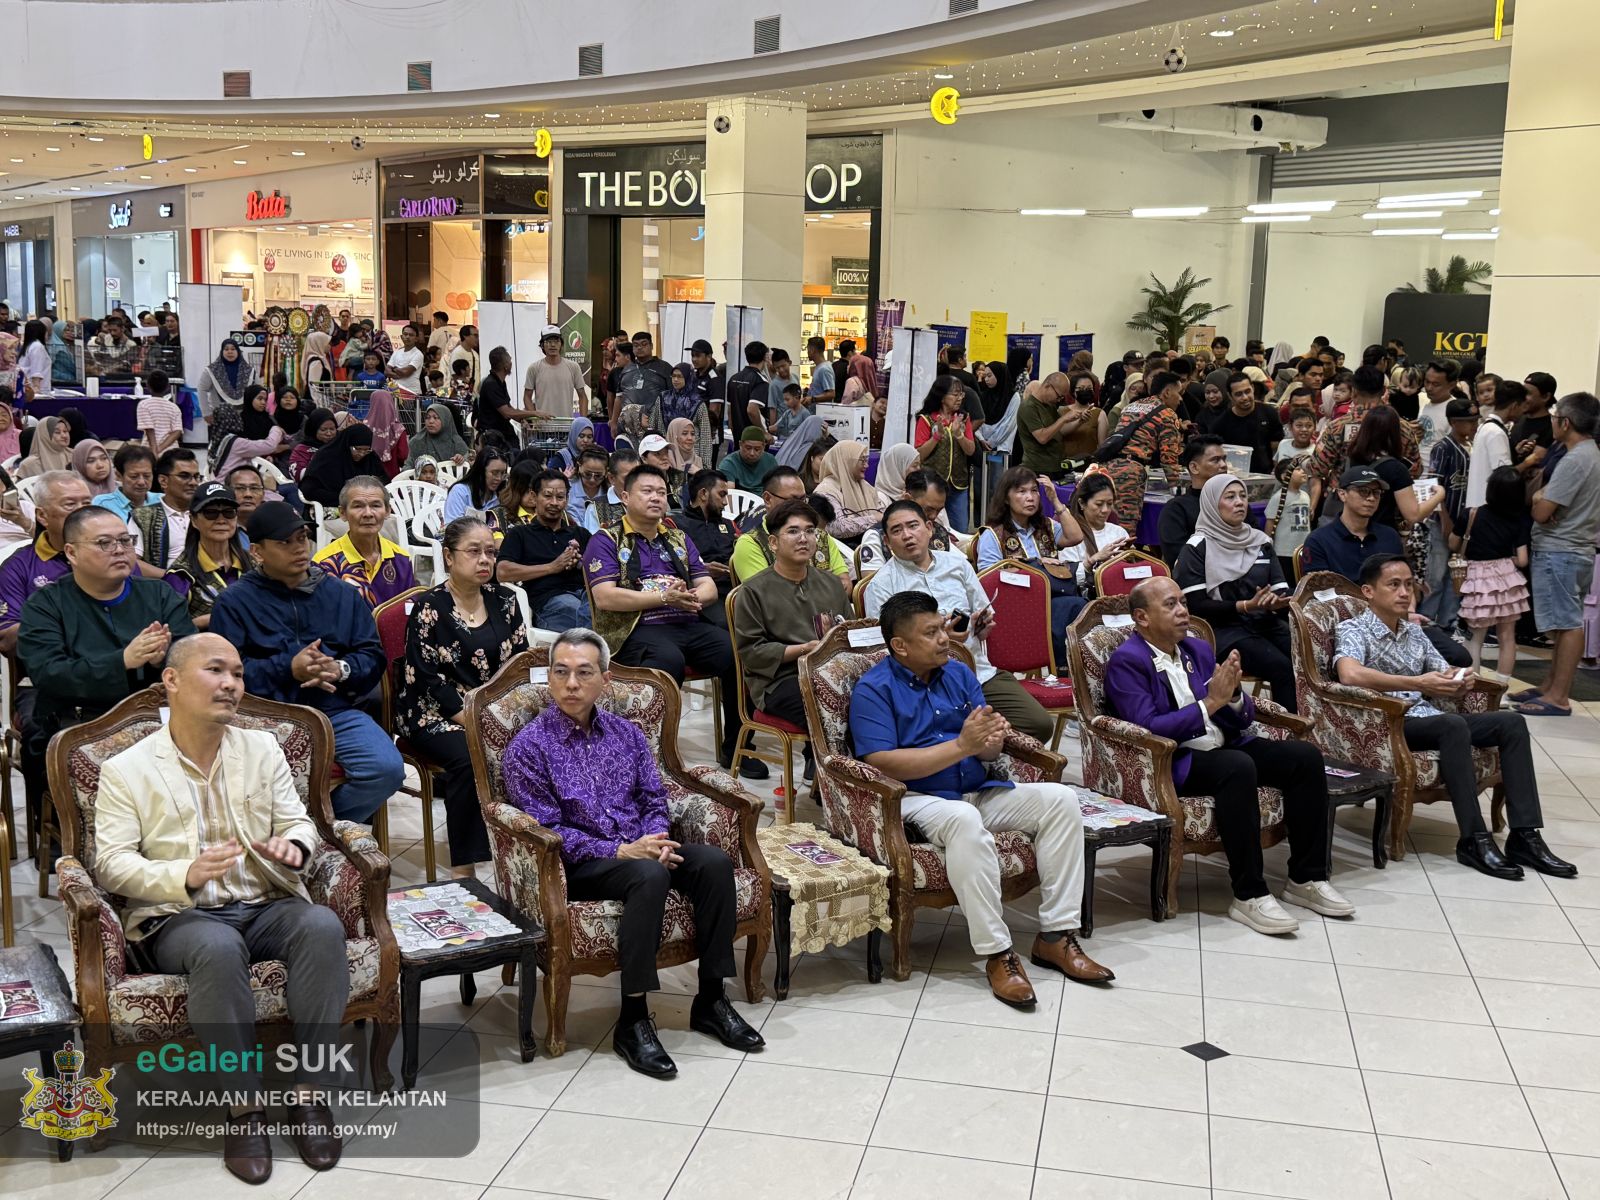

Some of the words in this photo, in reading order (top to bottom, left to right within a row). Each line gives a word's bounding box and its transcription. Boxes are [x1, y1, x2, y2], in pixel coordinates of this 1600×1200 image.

[577, 171, 643, 208] THE
[648, 169, 707, 207] BO
[805, 163, 863, 204] OP
[246, 190, 286, 221] Bata
[259, 248, 283, 257] LOVE
[284, 250, 312, 259] LIVING
[314, 251, 323, 259] IN
[353, 253, 373, 262] SINC
[839, 272, 860, 283] 100%
[861, 272, 869, 283] V
